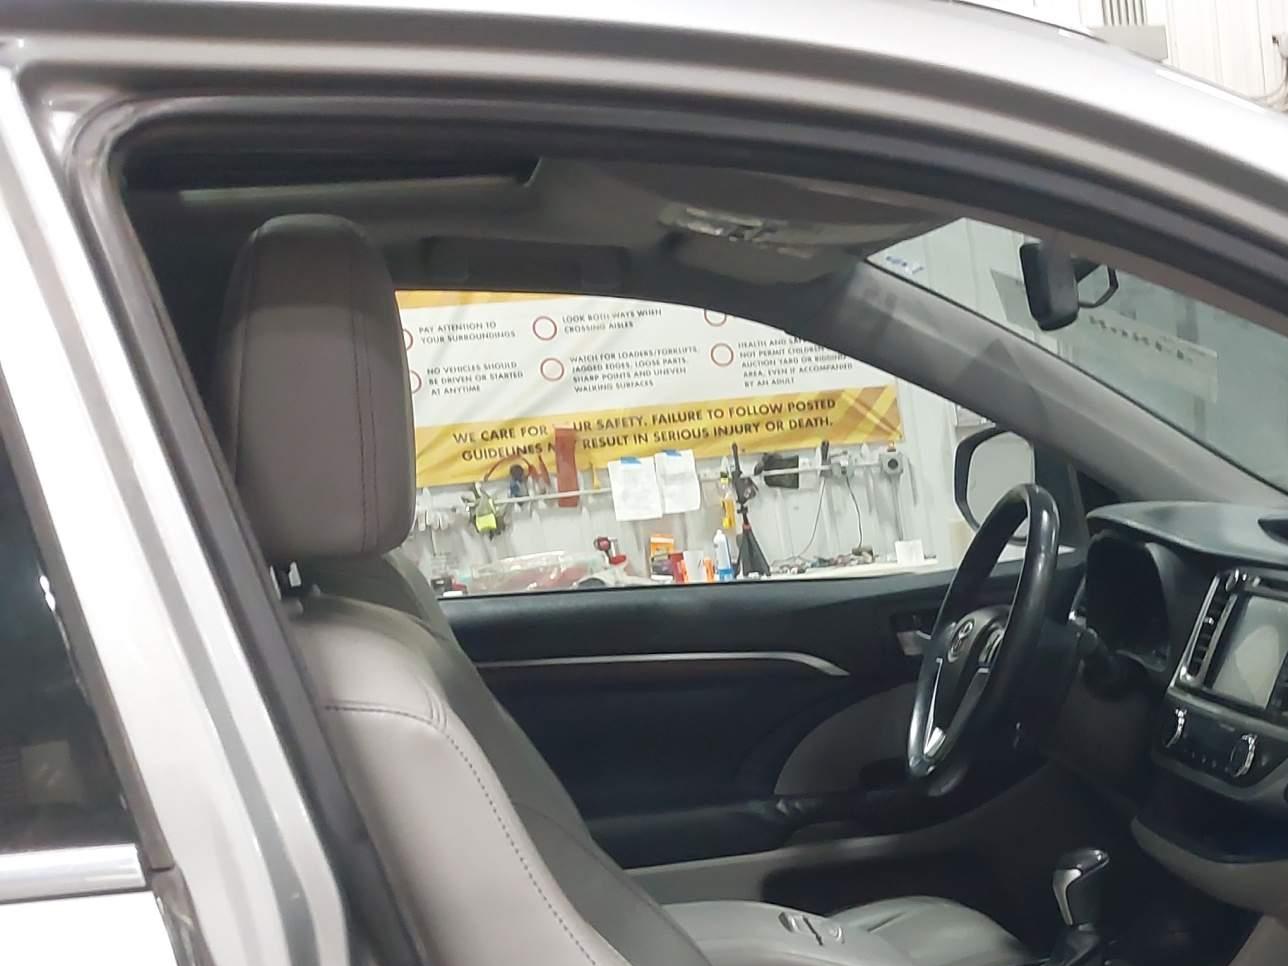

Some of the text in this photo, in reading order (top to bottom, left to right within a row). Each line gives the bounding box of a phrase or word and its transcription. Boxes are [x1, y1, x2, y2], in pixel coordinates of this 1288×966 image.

[562, 313, 585, 323] LOOK
[612, 309, 635, 319] WAYS
[636, 308, 662, 317] WHEN
[419, 320, 496, 334] PAY ATTENTION TO
[564, 321, 634, 334] CROSSING AISLES
[421, 330, 516, 344] YOUR SURROUNDINGS
[738, 340, 767, 349] HEALTH
[769, 338, 786, 346] AND
[570, 352, 598, 363] WATCH
[600, 351, 616, 361] FOR
[739, 349, 756, 358] NOT
[758, 348, 785, 357] PERMIT
[427, 361, 517, 375] NO VEHICLES SHOULD
[572, 363, 603, 373] JAGGED
[635, 358, 660, 368] LOOSE
[742, 359, 776, 368] AUCTION
[780, 356, 799, 366] YARD
[801, 355, 812, 363] OR
[573, 367, 686, 383] SHARP POINTS AND UNEVEN
[768, 368, 788, 377] EVEN
[799, 362, 853, 374] ACCOMPANIED
[429, 370, 524, 386] BE DRIVEN OR STARTED
[744, 377, 795, 388] BY AN ADULT
[431, 385, 481, 396] AT ANYTIME
[574, 380, 654, 393] WALKING SURFACES
[453, 431, 476, 444] WE
[480, 427, 516, 442] CARE
[520, 424, 549, 438] FOR
[652, 409, 702, 425] FAILURE
[707, 407, 724, 420] TO
[729, 403, 783, 418] FOLLOW
[788, 398, 836, 413] POSTED
[462, 442, 543, 462] GUIDELINES
[582, 433, 630, 450] RESULT
[634, 432, 648, 445] IN
[654, 426, 710, 443] SERIOUS
[714, 422, 760, 438] INJURY
[765, 420, 784, 432] OR
[789, 415, 833, 430] DEATH.
